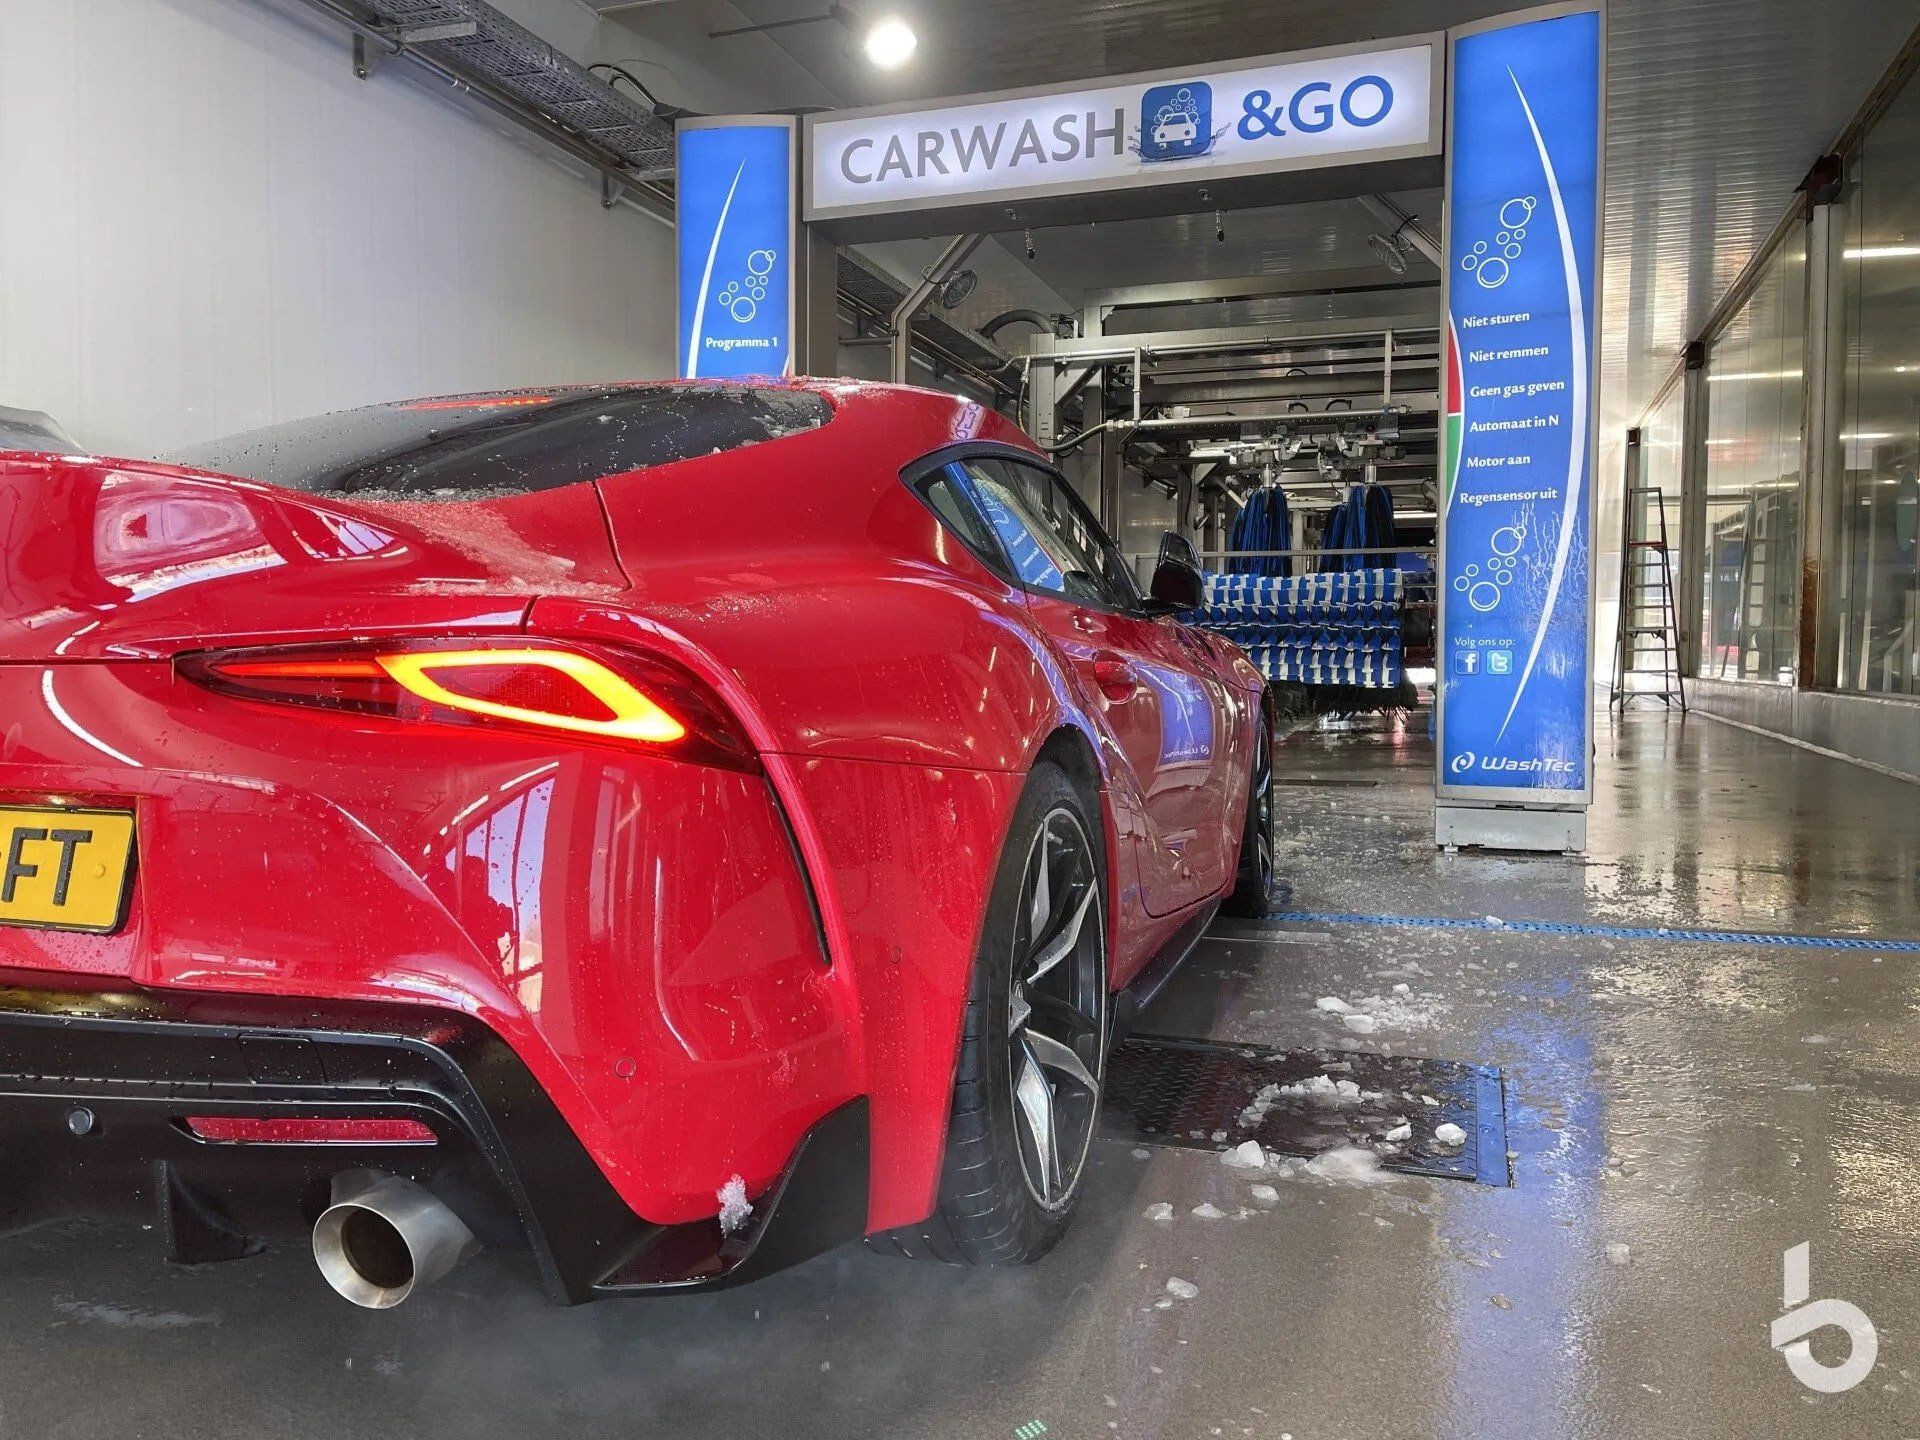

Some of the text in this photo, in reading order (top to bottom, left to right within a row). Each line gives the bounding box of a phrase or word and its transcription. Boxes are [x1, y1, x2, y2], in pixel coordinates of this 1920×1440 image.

[841, 75, 1394, 184] CARWASH &GO
[1463, 312, 1530, 328] Niet sturen
[705, 336, 778, 351] Programma 1
[1469, 346, 1549, 362] Niet remmen
[1470, 381, 1565, 398] Geen gas geven
[1469, 414, 1559, 432] Automaat in N
[1467, 455, 1531, 468] Motor aan
[1460, 487, 1558, 506] Regensensor uit
[1454, 637, 1476, 649] Volg
[1499, 638, 1516, 648] op:
[1481, 756, 1576, 772] WashTec
